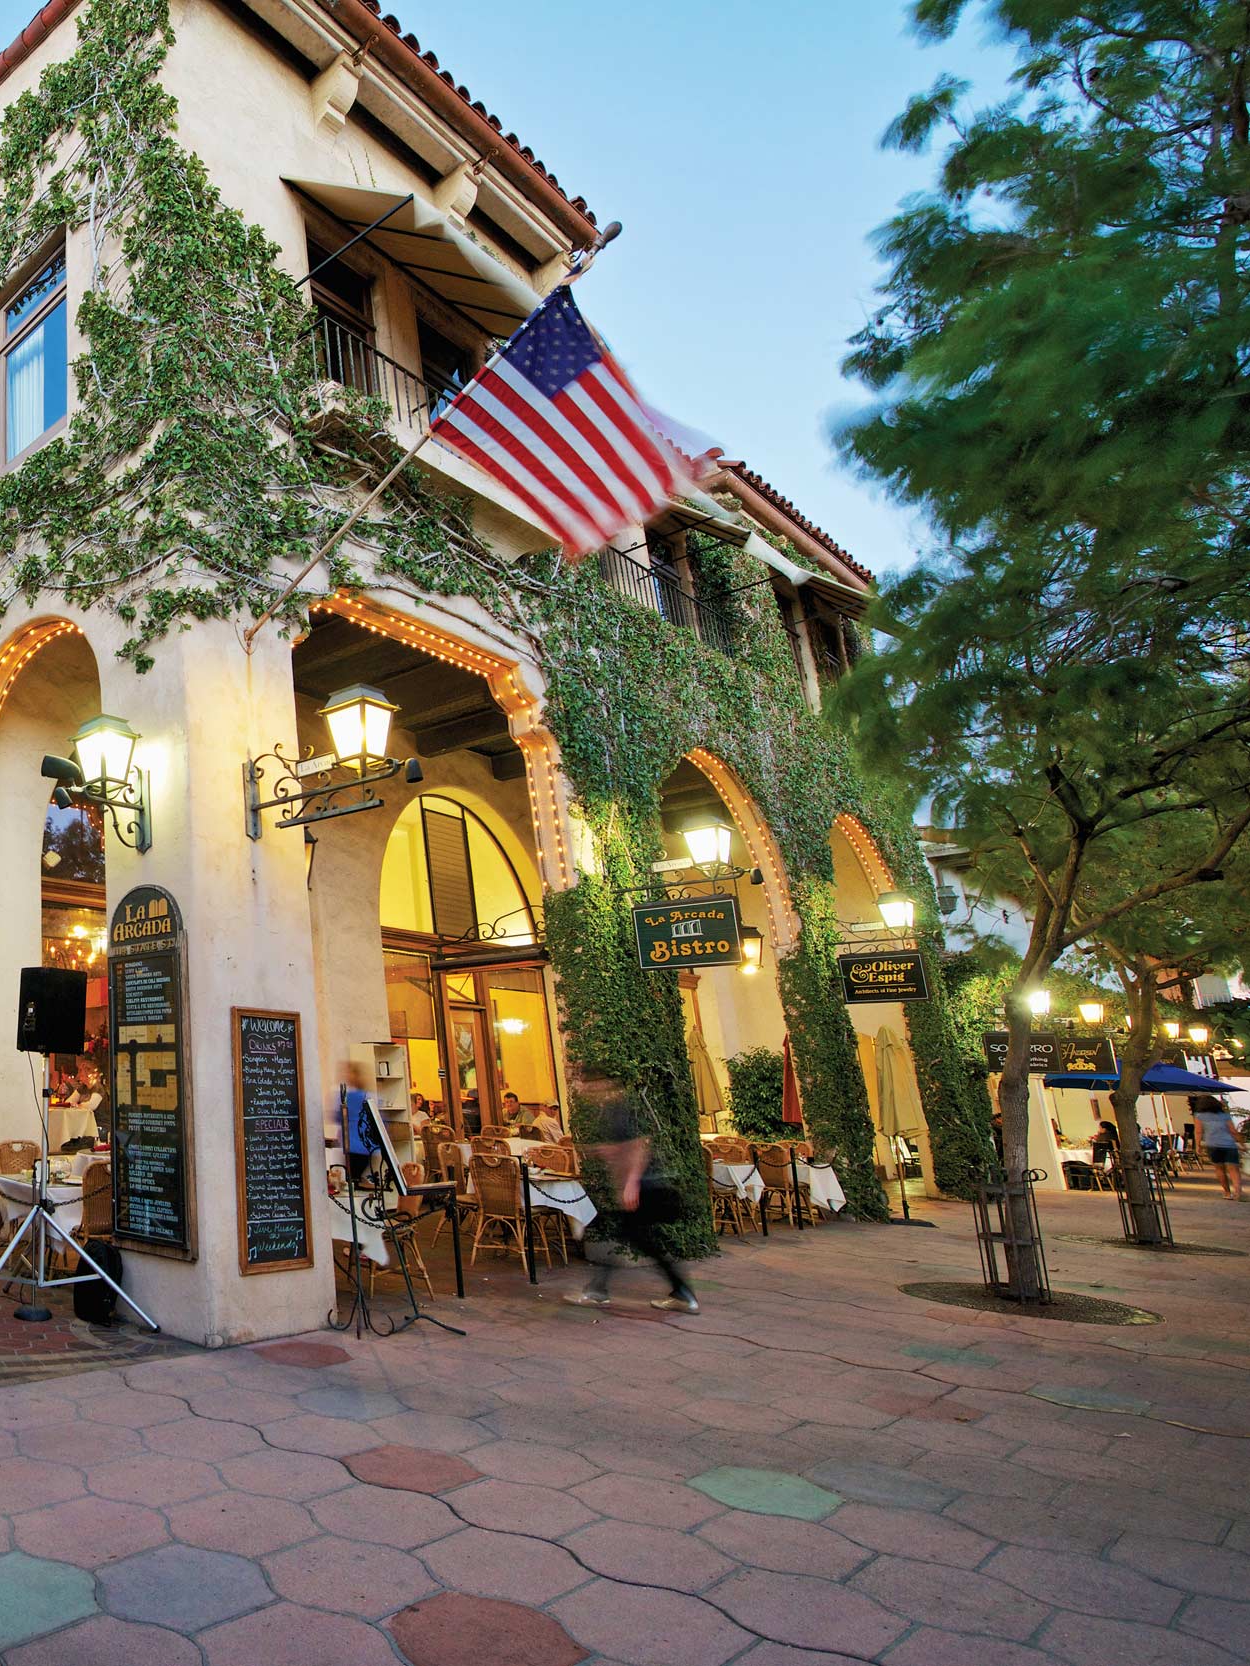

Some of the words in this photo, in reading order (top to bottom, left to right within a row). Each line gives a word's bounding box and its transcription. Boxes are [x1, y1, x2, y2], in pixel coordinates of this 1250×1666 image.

[125, 904, 145, 923] LA
[644, 915, 666, 927] La
[669, 909, 725, 923] Arcada
[113, 917, 172, 943] ARCADA
[130, 941, 158, 953] STATE
[649, 939, 730, 963] Bistro
[872, 960, 915, 972] Oliver
[869, 971, 905, 984] Espig
[854, 987, 880, 995] Architects
[990, 1043, 1053, 1053] SORO
[254, 1119, 290, 1130] SPECIALS
